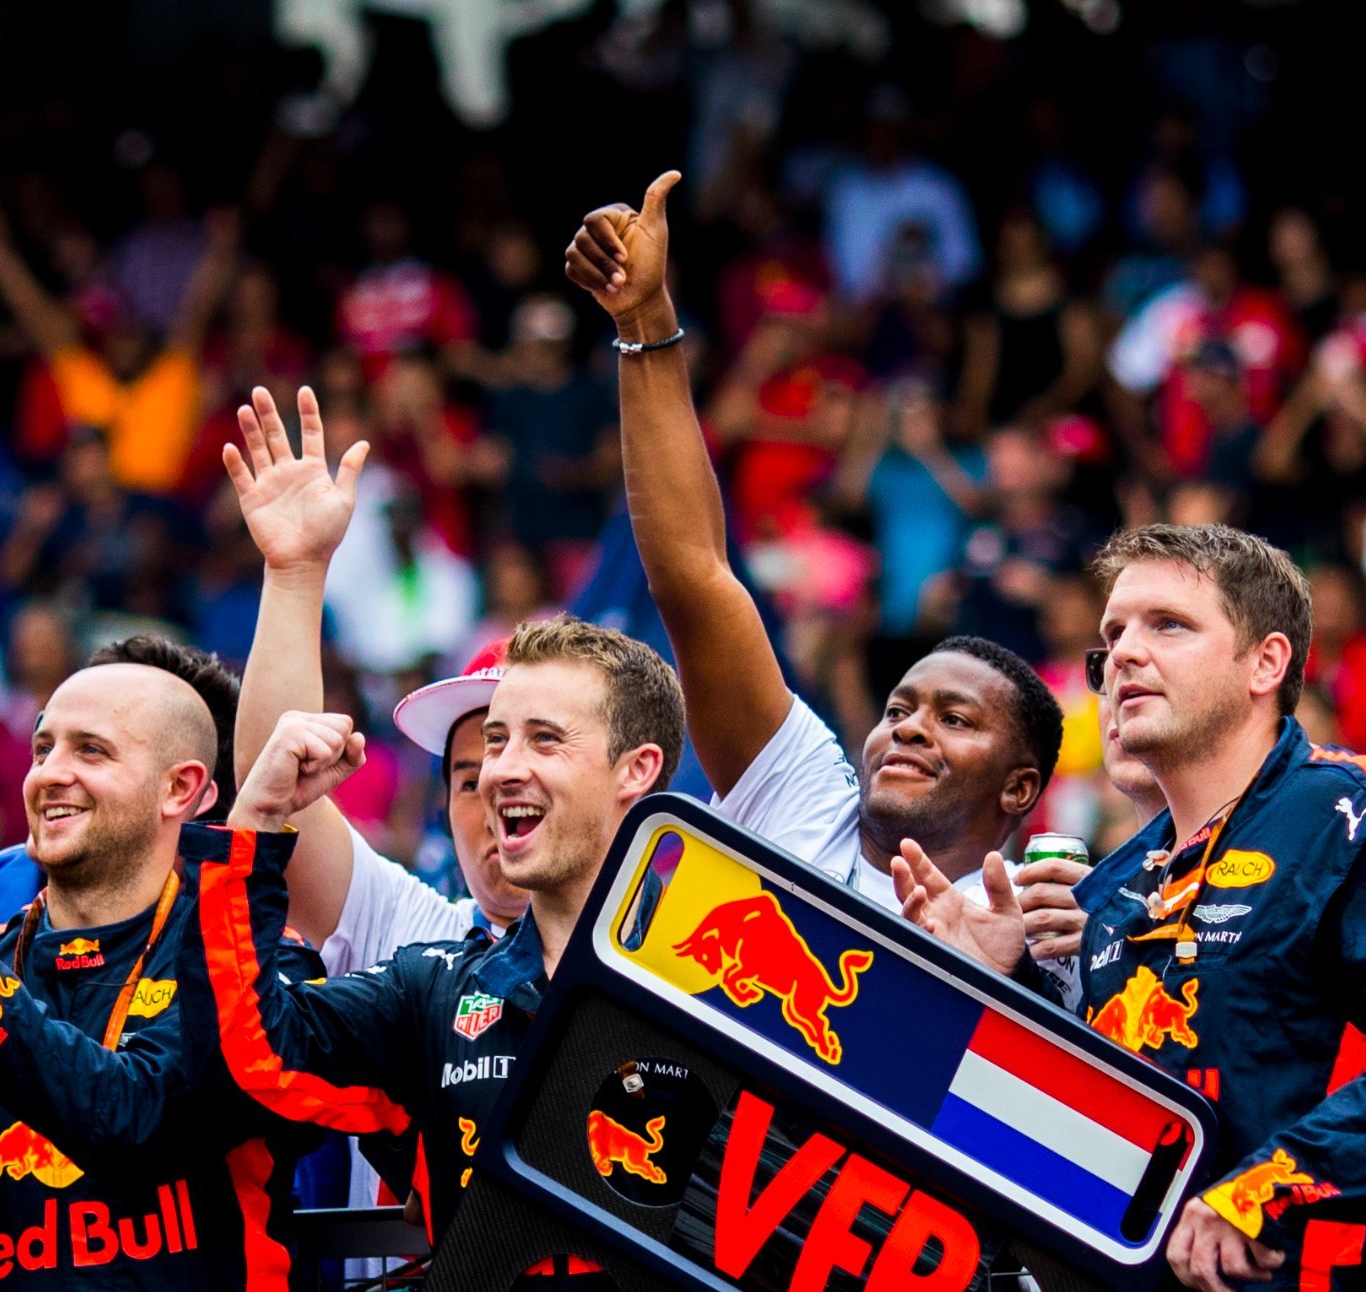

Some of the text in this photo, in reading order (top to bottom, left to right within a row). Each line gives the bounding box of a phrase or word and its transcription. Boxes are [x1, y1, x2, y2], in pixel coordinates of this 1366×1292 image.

[55, 954, 105, 971] Red Bull
[135, 989, 172, 1008] AUCH
[69, 1178, 198, 1267] Bull
